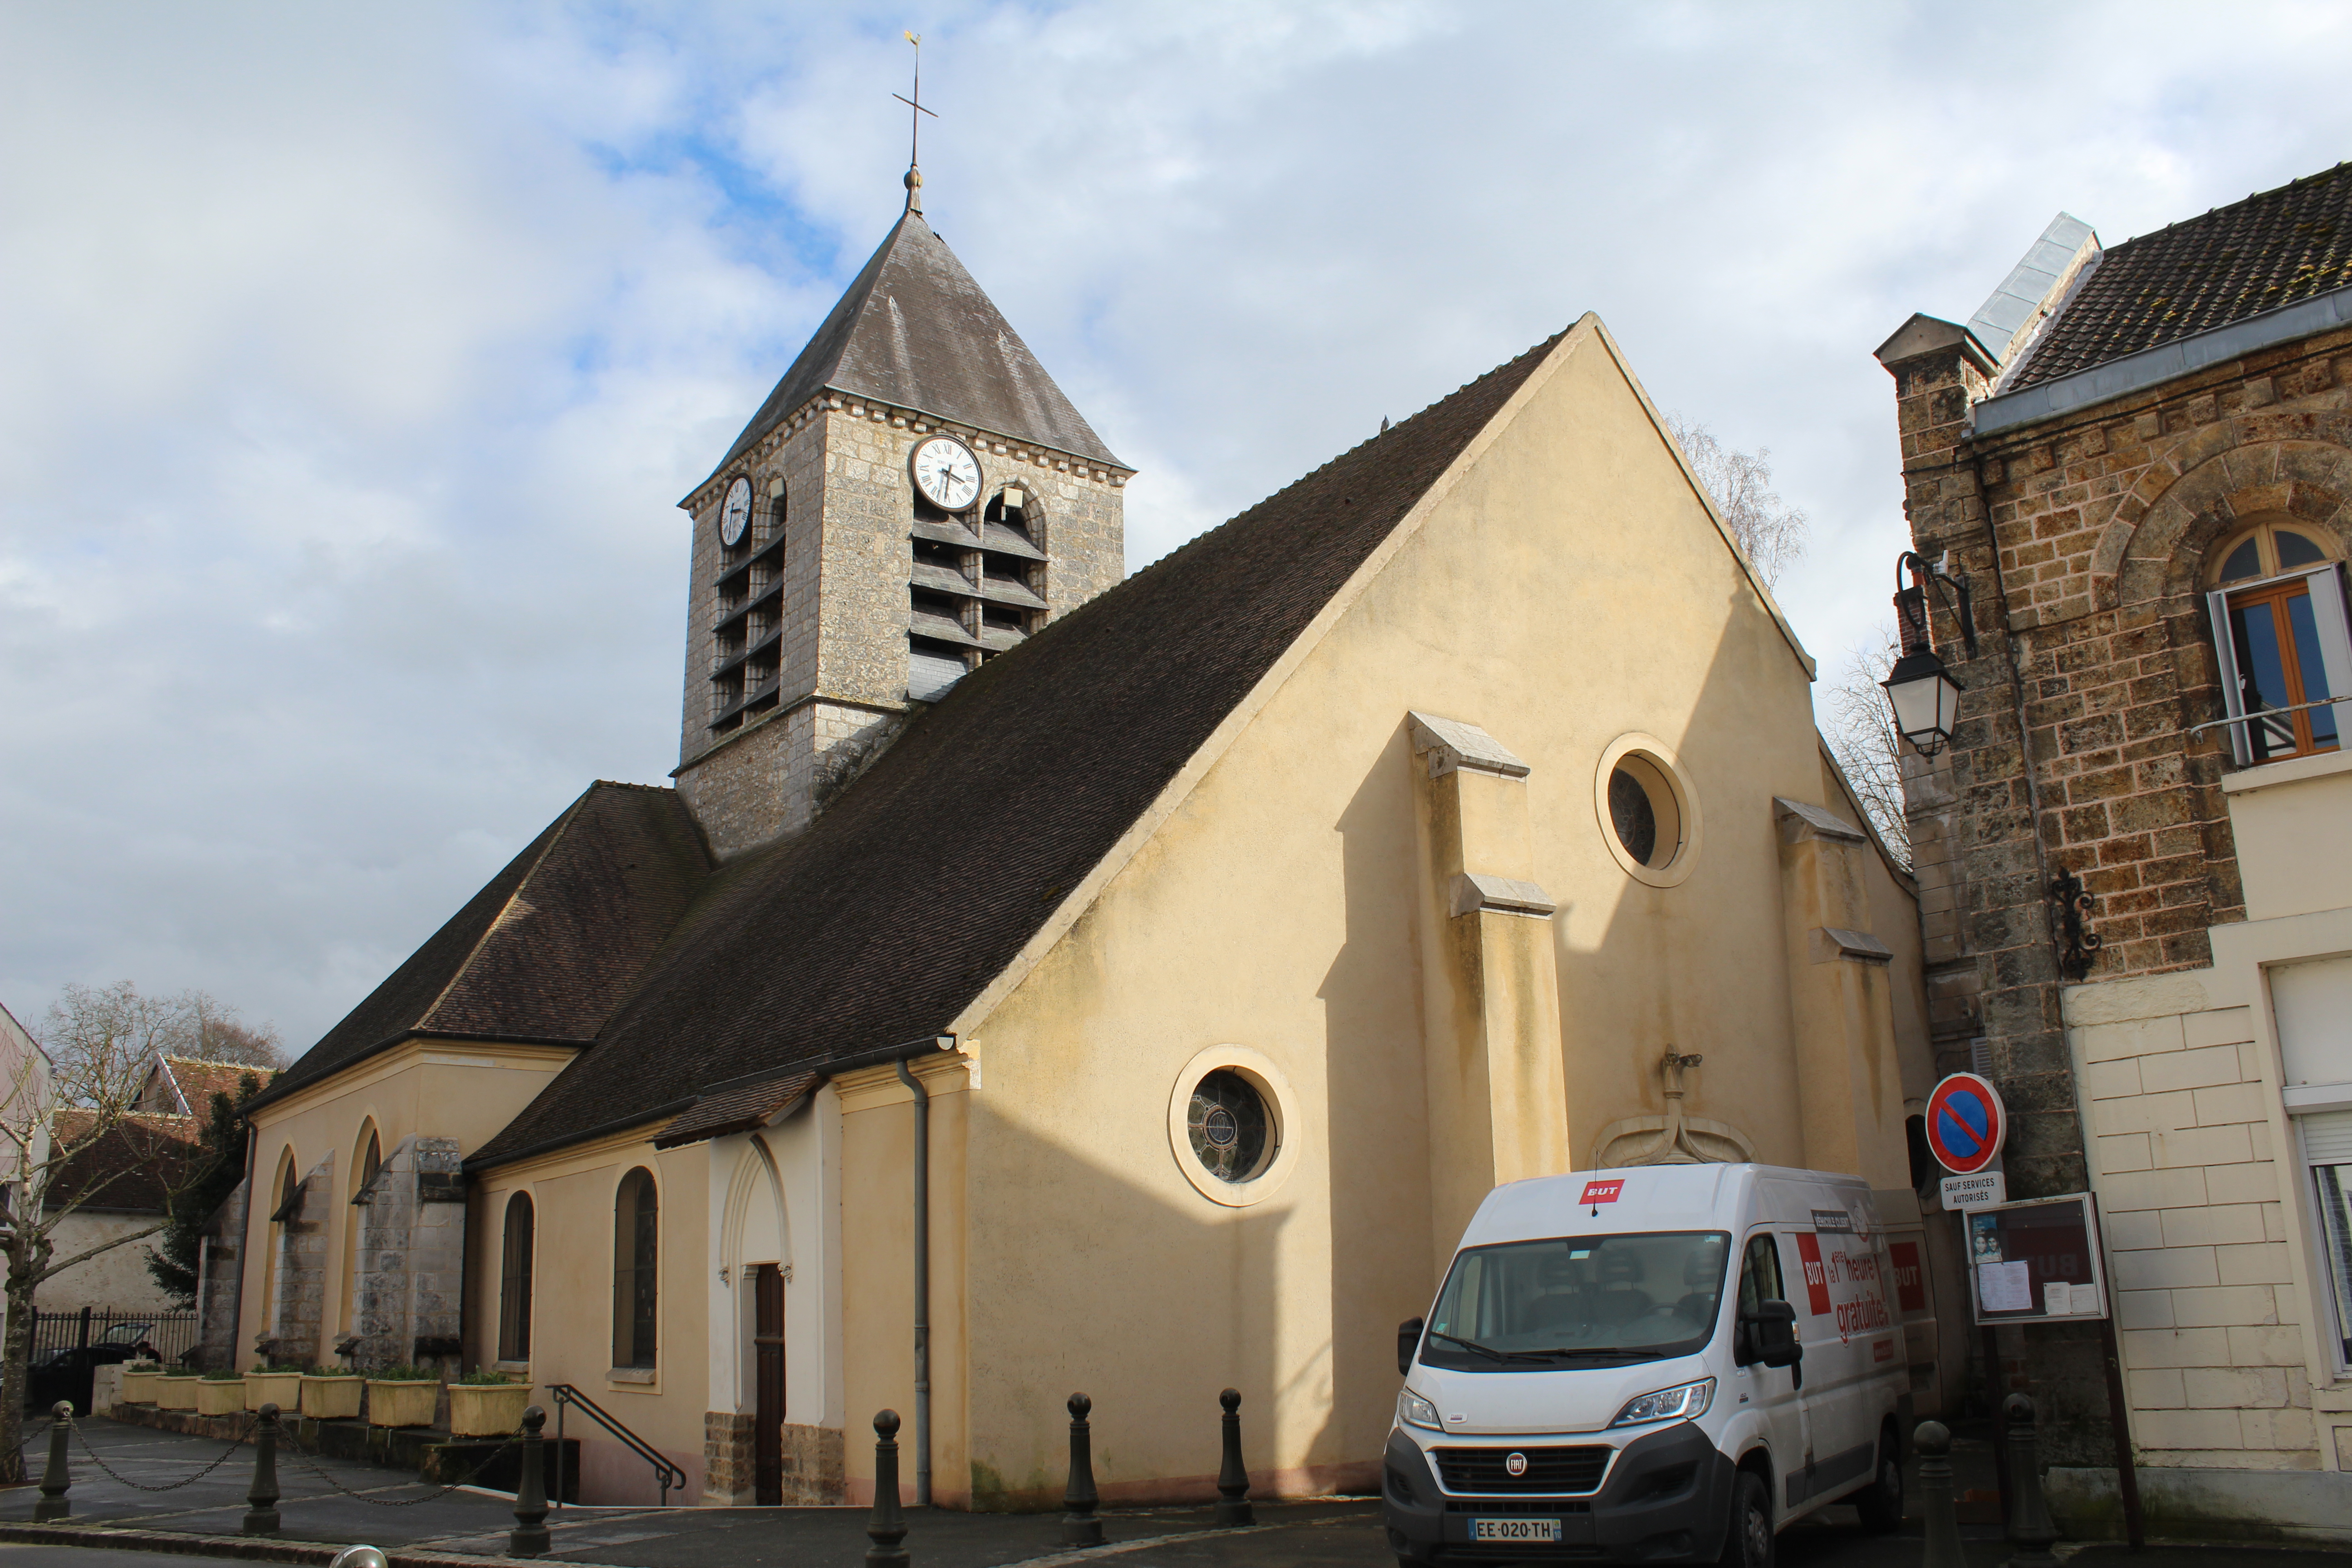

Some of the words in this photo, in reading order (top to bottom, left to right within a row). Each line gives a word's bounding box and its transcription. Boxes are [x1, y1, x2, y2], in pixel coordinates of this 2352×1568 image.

[1588, 1187, 1618, 1196] BUT
[1945, 1182, 1961, 1192] SAUF
[1963, 1177, 1994, 1190] SERVICES
[1954, 1190, 1989, 1204] AUTORISÉS
[1805, 1261, 1823, 1286] BUT
[1828, 1265, 1836, 1284] la
[1843, 1251, 1874, 1281] heure
[1893, 1266, 1917, 1287] BUT
[1837, 1290, 1884, 1346] gratuite
[1510, 1459, 1523, 1470] FIAT
